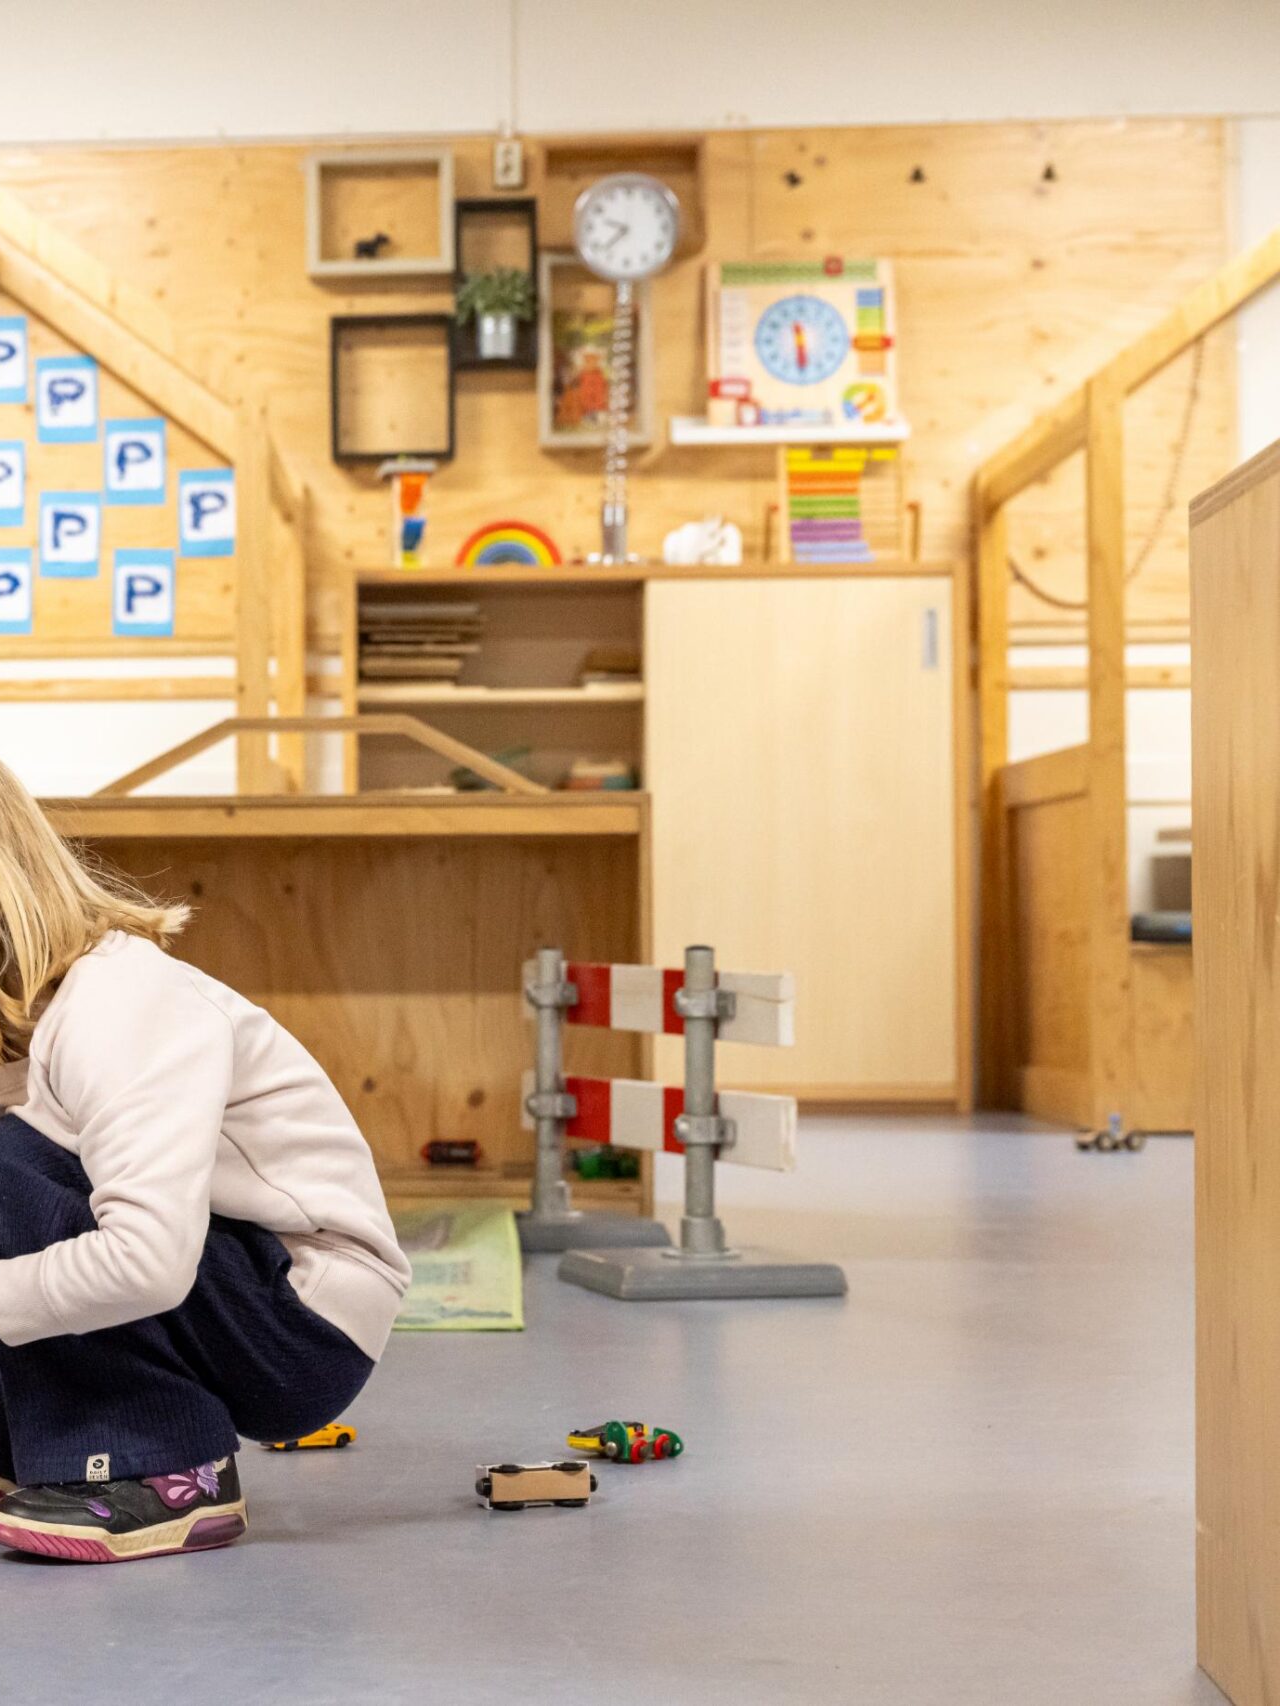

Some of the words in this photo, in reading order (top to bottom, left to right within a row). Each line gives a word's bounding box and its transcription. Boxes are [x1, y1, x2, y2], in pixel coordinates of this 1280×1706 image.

[48, 378, 85, 416] P
[117, 441, 152, 480] P
[190, 491, 227, 529] P
[53, 511, 87, 549] P
[126, 574, 162, 613] P
